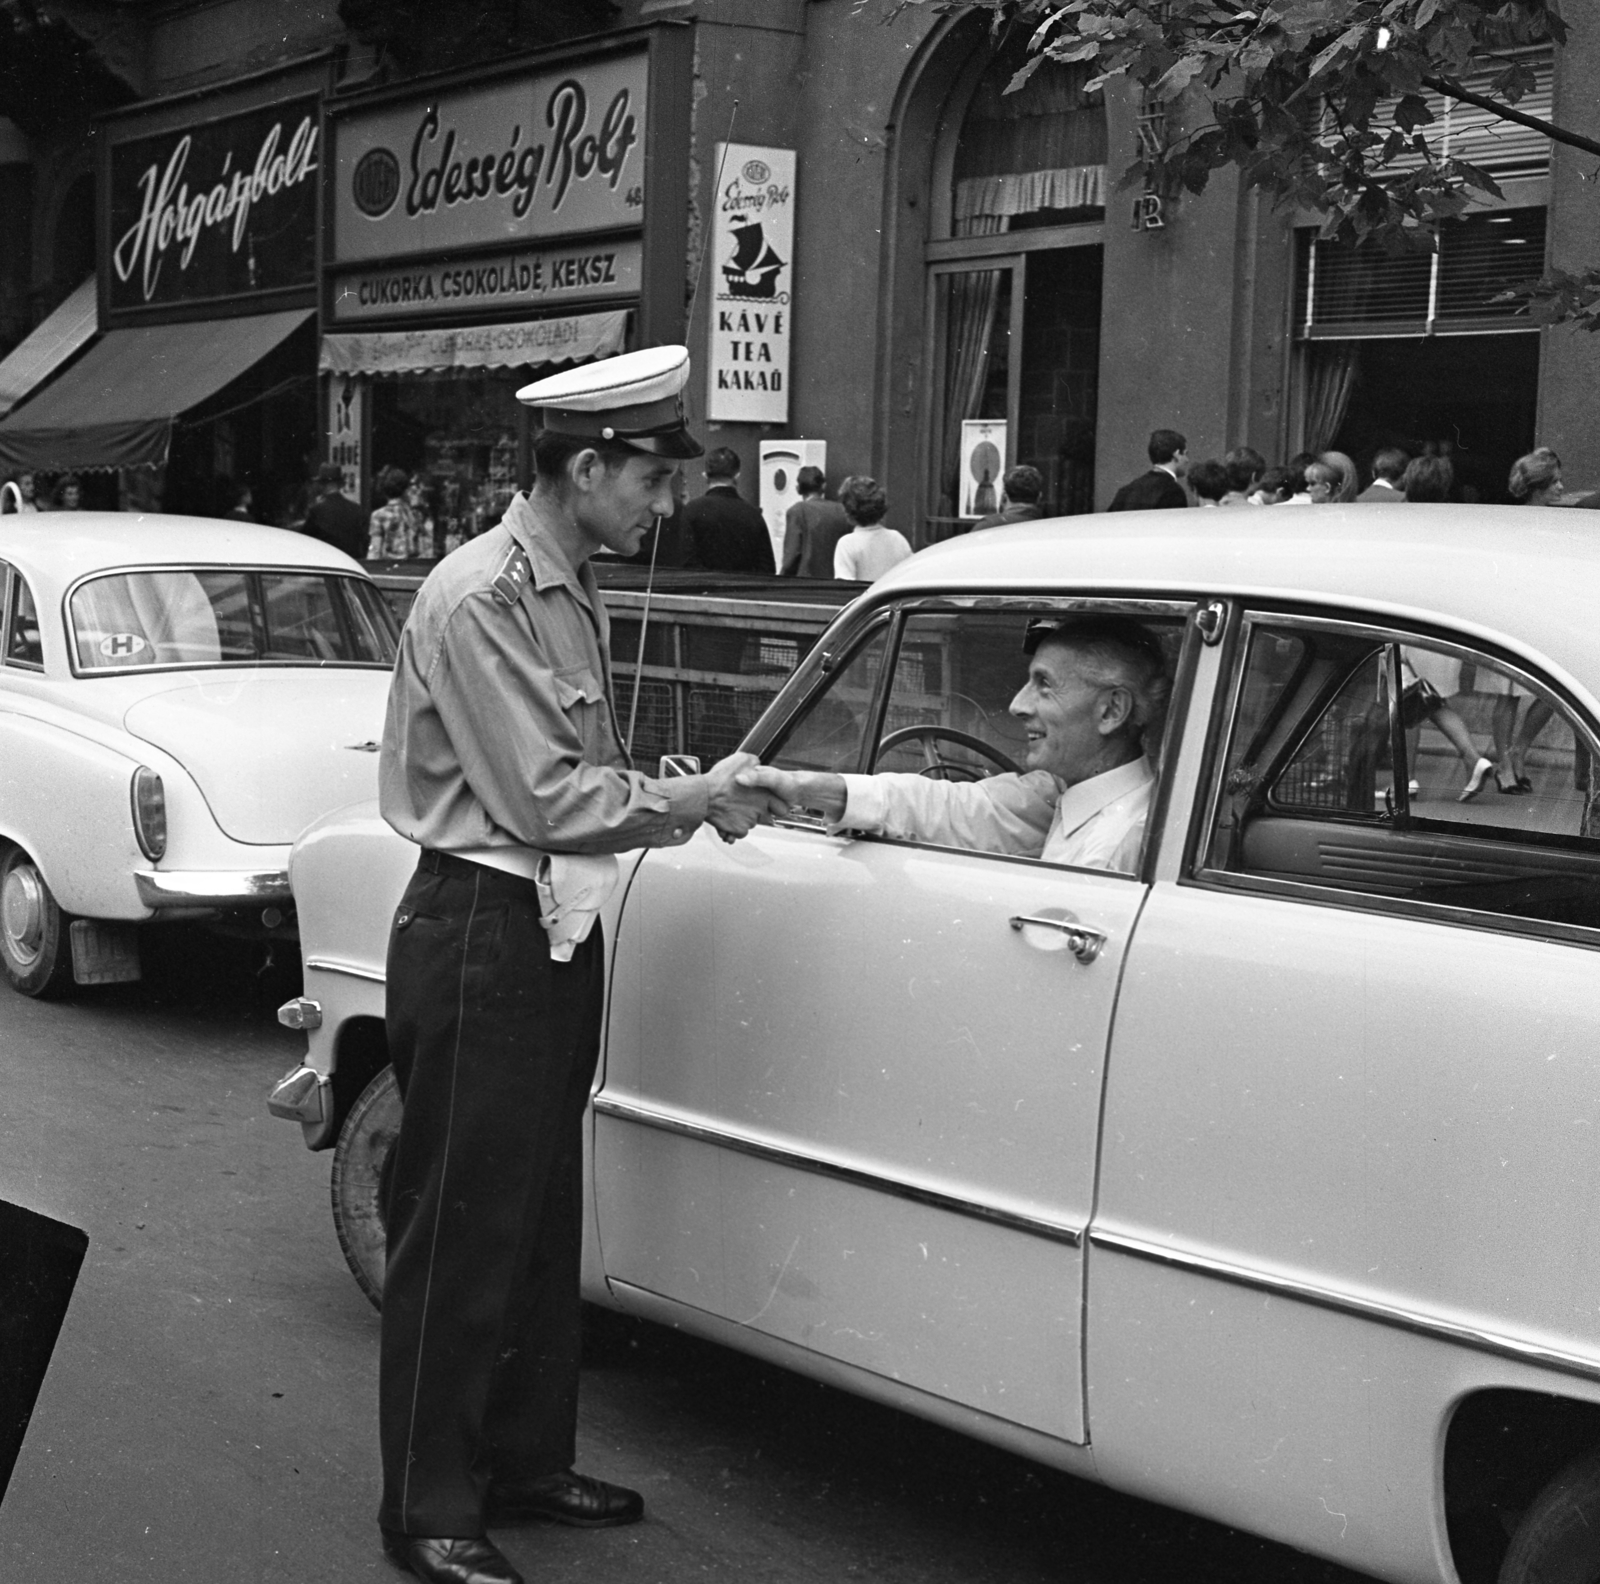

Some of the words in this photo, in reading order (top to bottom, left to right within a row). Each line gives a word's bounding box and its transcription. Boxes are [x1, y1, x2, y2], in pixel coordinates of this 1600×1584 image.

[405, 102, 546, 217] Édesség
[546, 78, 636, 211] Bolt
[113, 115, 320, 301] Horgászbolt
[551, 253, 617, 290] KEKSZ
[719, 308, 784, 334] KÁVÉ
[730, 340, 772, 362] TEA
[718, 368, 782, 391] KAKAÓ
[111, 635, 133, 655] H
